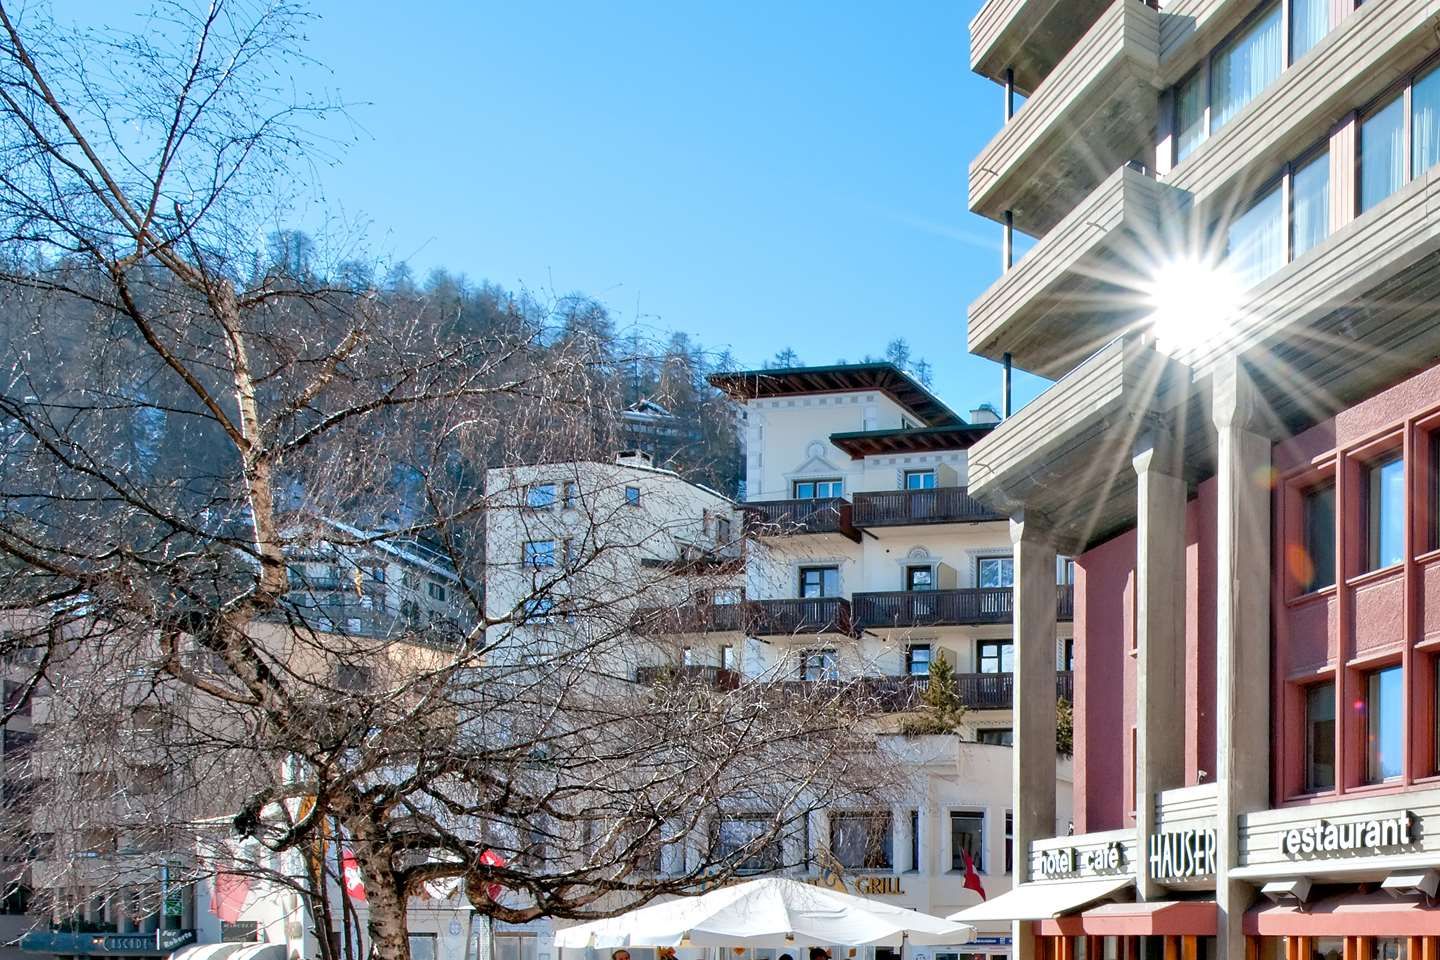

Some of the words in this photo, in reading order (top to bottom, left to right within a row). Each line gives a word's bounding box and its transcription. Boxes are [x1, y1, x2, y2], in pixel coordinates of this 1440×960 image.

[1278, 809, 1410, 853] restaurant
[1039, 847, 1073, 874] hotel
[1086, 842, 1119, 869] café
[1149, 828, 1217, 879] HAUSER
[855, 876, 905, 895] GRILL
